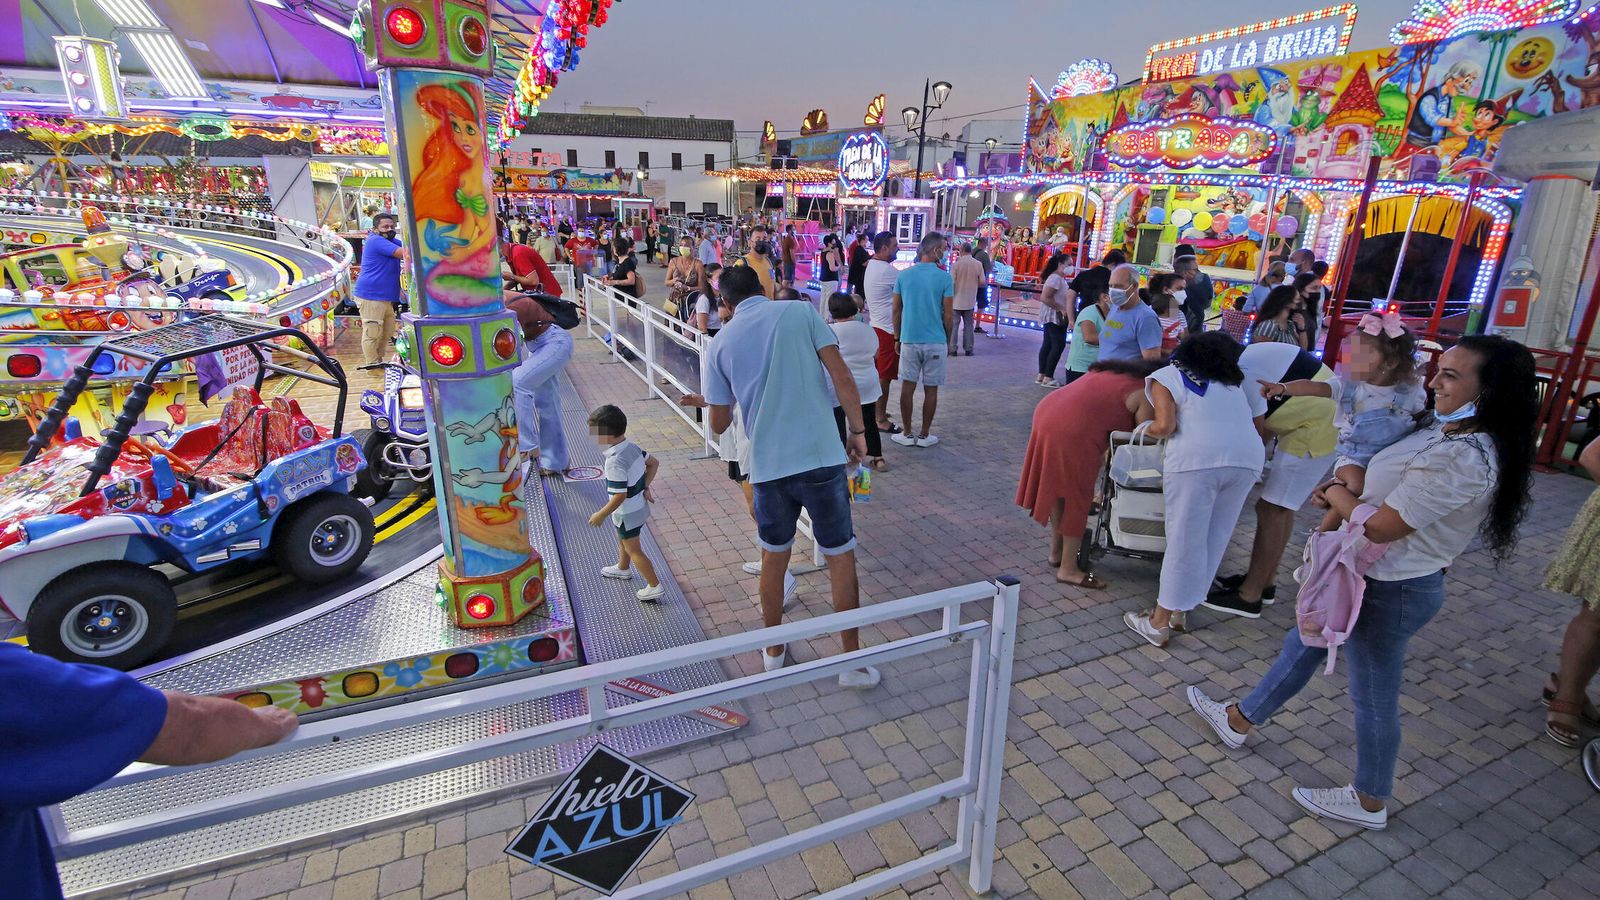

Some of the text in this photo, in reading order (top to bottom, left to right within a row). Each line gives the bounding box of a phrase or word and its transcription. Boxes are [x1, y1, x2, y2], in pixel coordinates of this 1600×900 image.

[1151, 25, 1337, 81] TREN DE LA BRUJA
[1123, 128, 1250, 153] ENTRADA
[861, 142, 873, 160] DE
[872, 143, 883, 171] LA
[225, 354, 239, 365] POR
[229, 364, 239, 374] DE
[226, 371, 247, 385] NIDAD
[275, 450, 330, 483] PAW
[289, 474, 327, 494] PATROL
[628, 681, 640, 690] LA
[698, 706, 728, 719] URIDAD
[551, 766, 651, 820] hielo
[531, 791, 684, 866] AZUL
